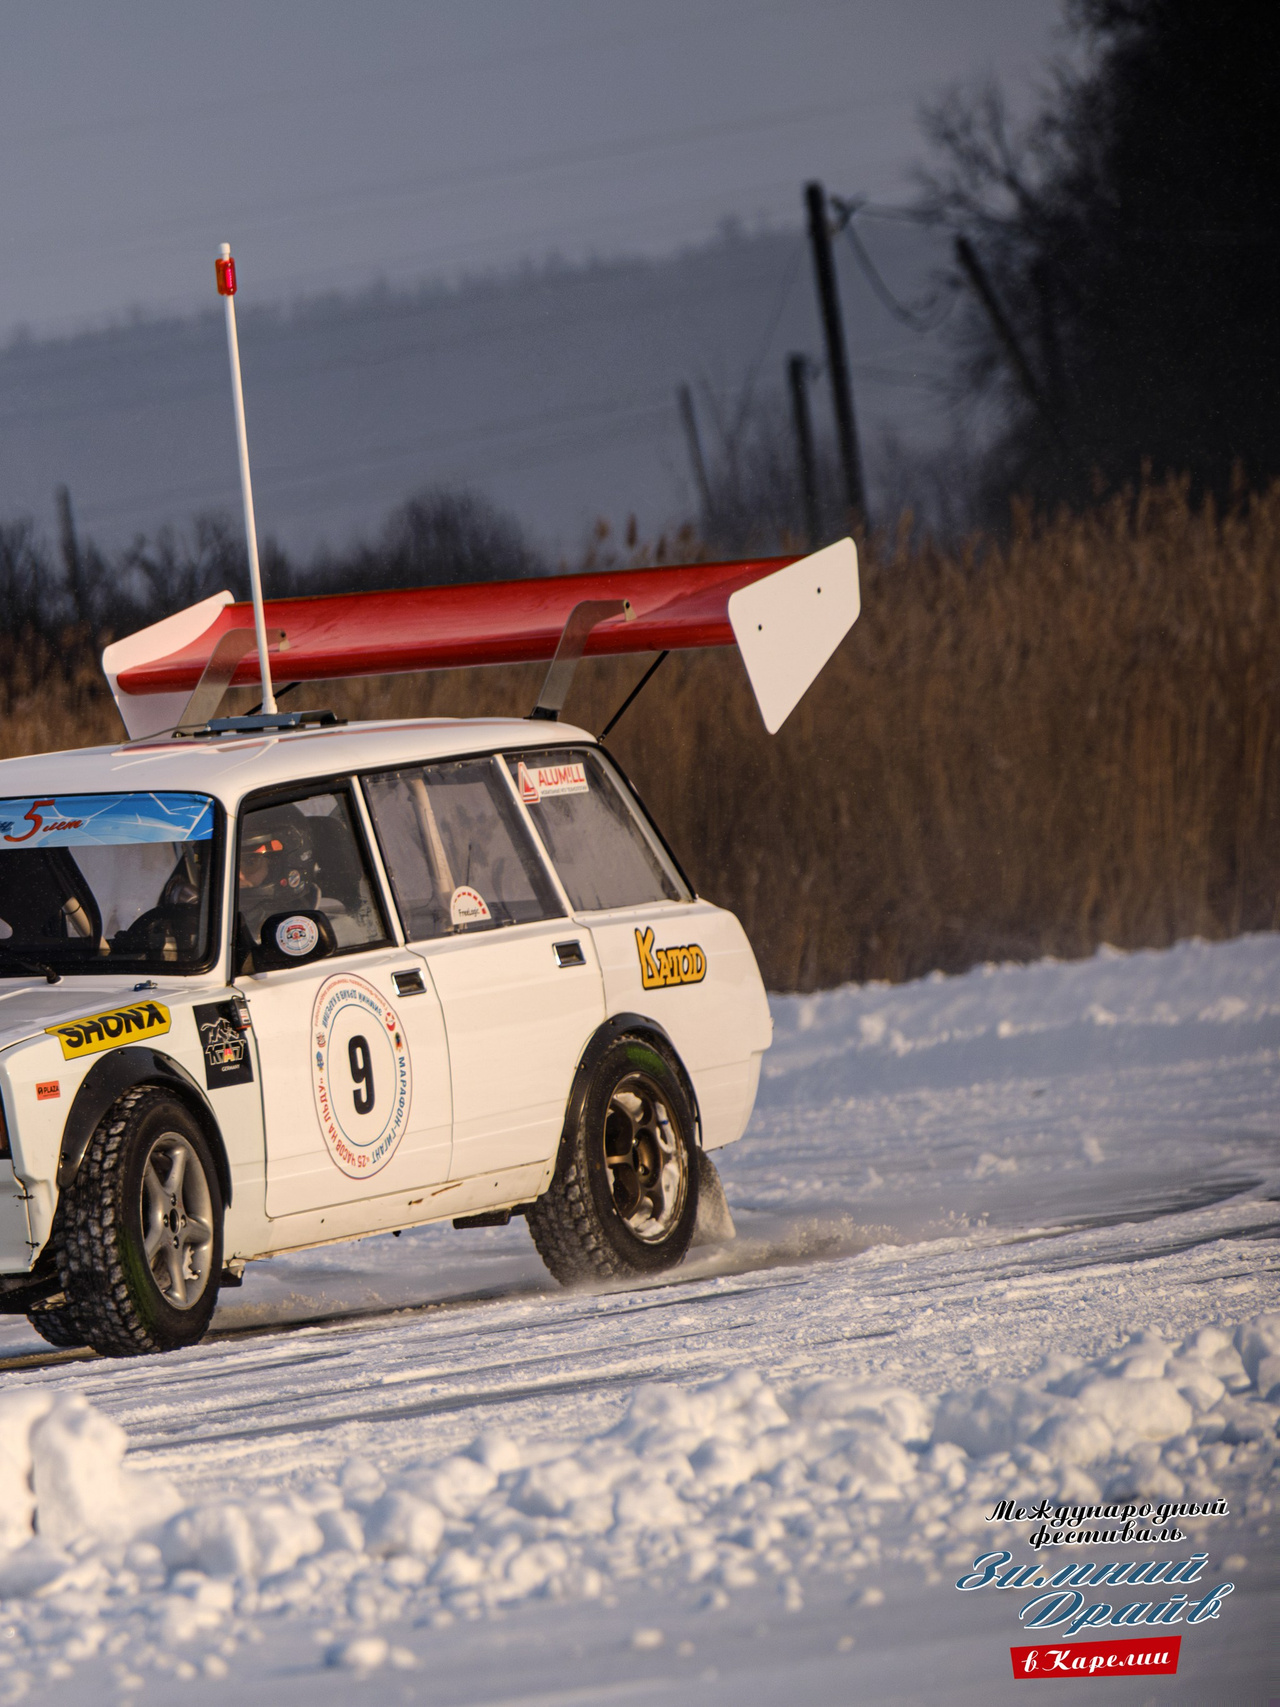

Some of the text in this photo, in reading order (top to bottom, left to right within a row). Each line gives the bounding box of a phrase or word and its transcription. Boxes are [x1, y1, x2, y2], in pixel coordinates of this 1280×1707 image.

[3, 799, 55, 842] 5
[42, 818, 83, 832] лет
[634, 925, 708, 991] KATOD
[348, 1035, 375, 1115] 9
